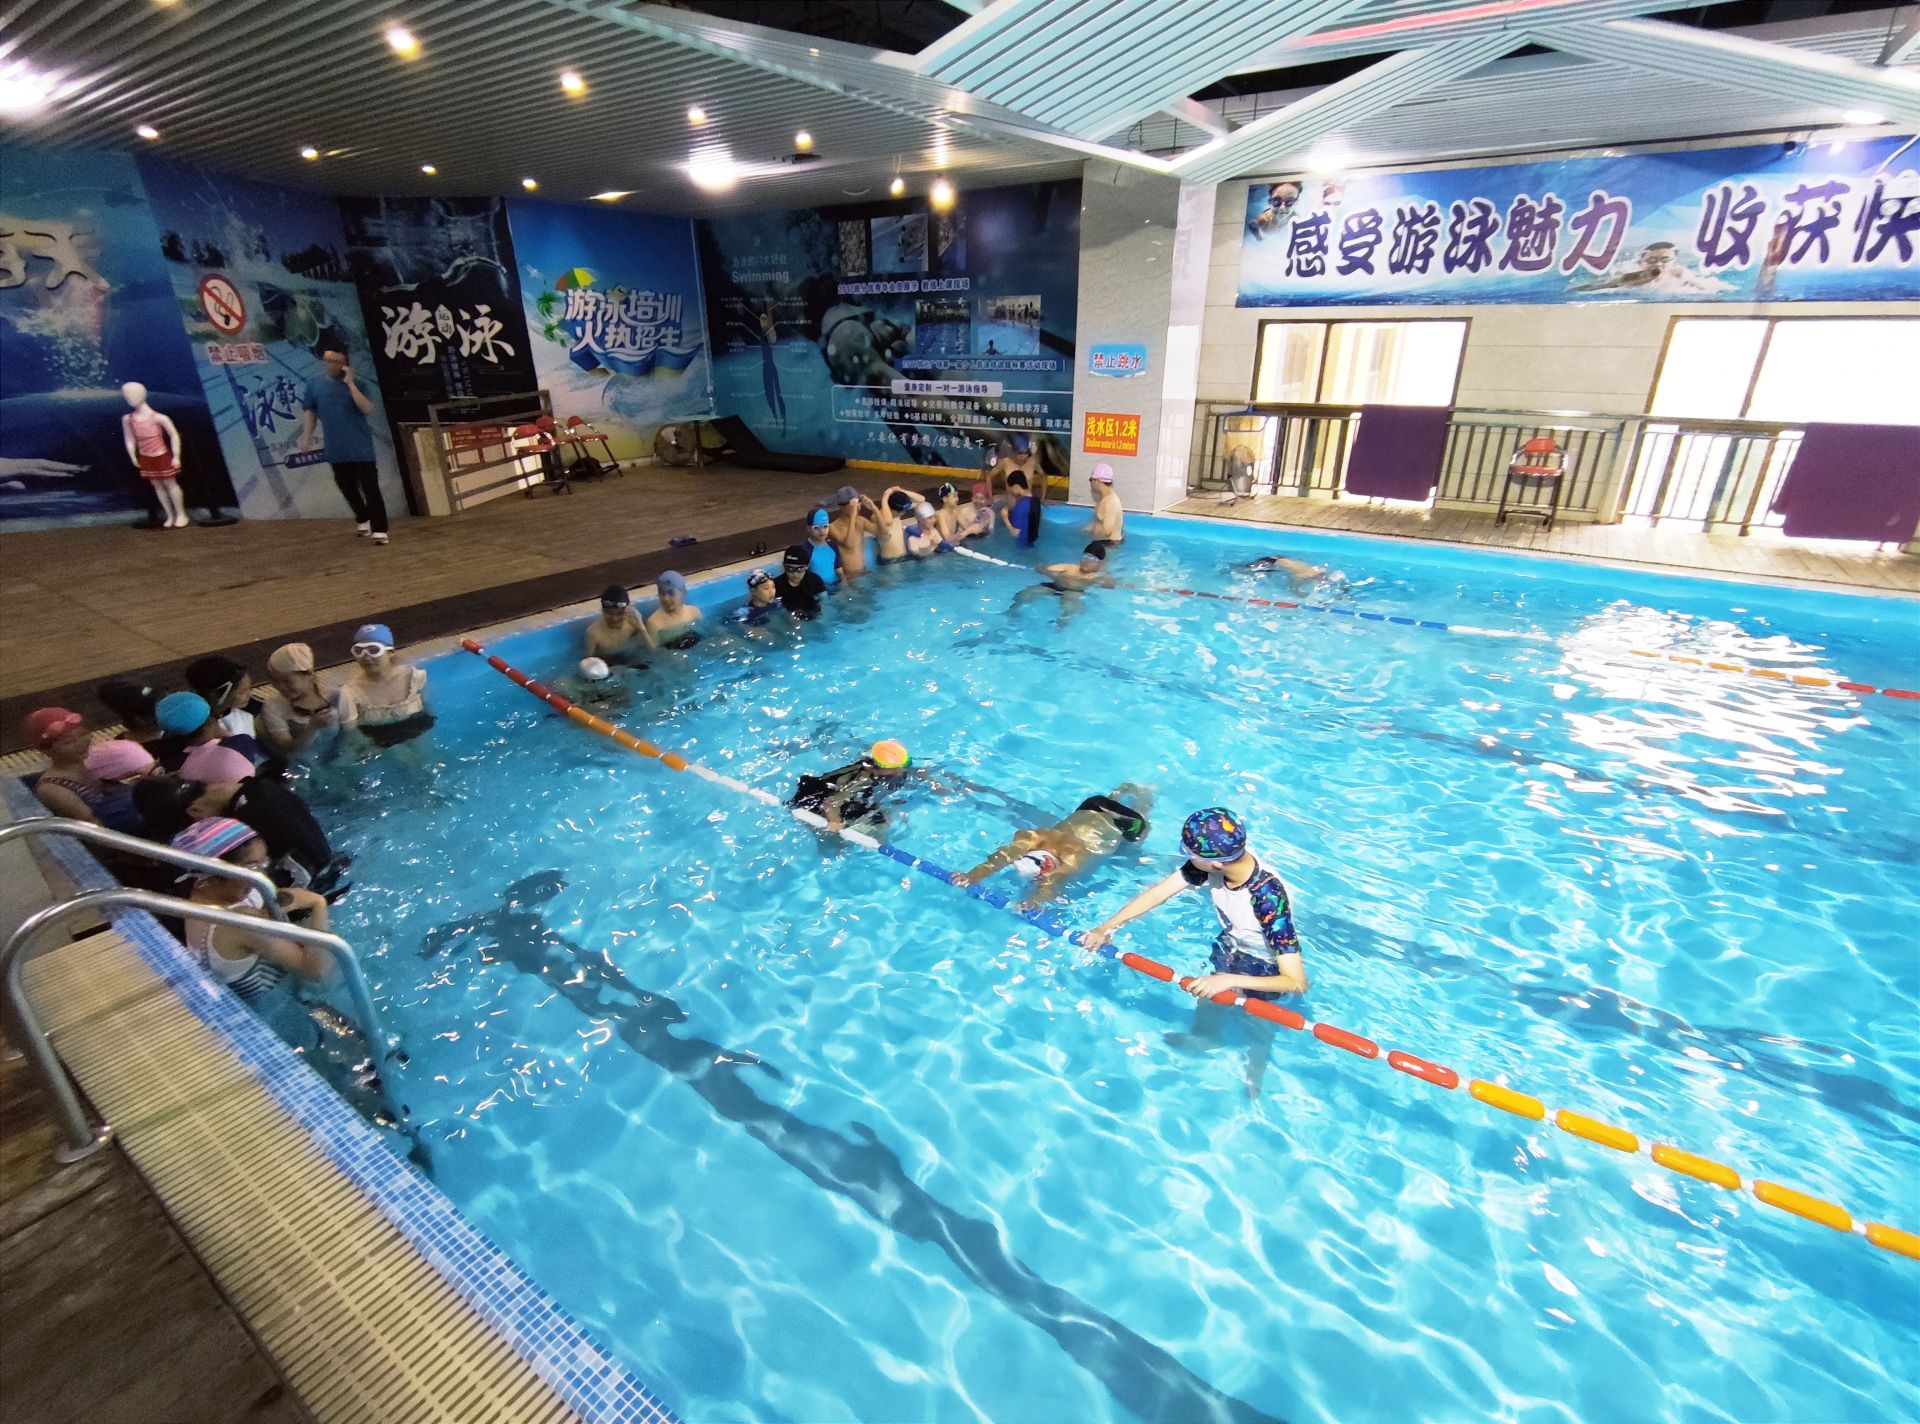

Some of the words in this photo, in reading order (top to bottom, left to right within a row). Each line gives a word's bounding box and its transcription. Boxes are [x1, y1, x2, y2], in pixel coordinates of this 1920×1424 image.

[1285, 194, 1628, 278] 感受游泳魅力
[1697, 179, 1920, 267] 收获快
[732, 268, 789, 284] Swimming
[565, 286, 683, 326] 游泳培训
[1094, 352, 1142, 369] 禁止跳水
[904, 382, 933, 392] 量身定制
[936, 384, 988, 393] 一对一游泳指导
[1086, 416, 1138, 439] 浅水区1.2米
